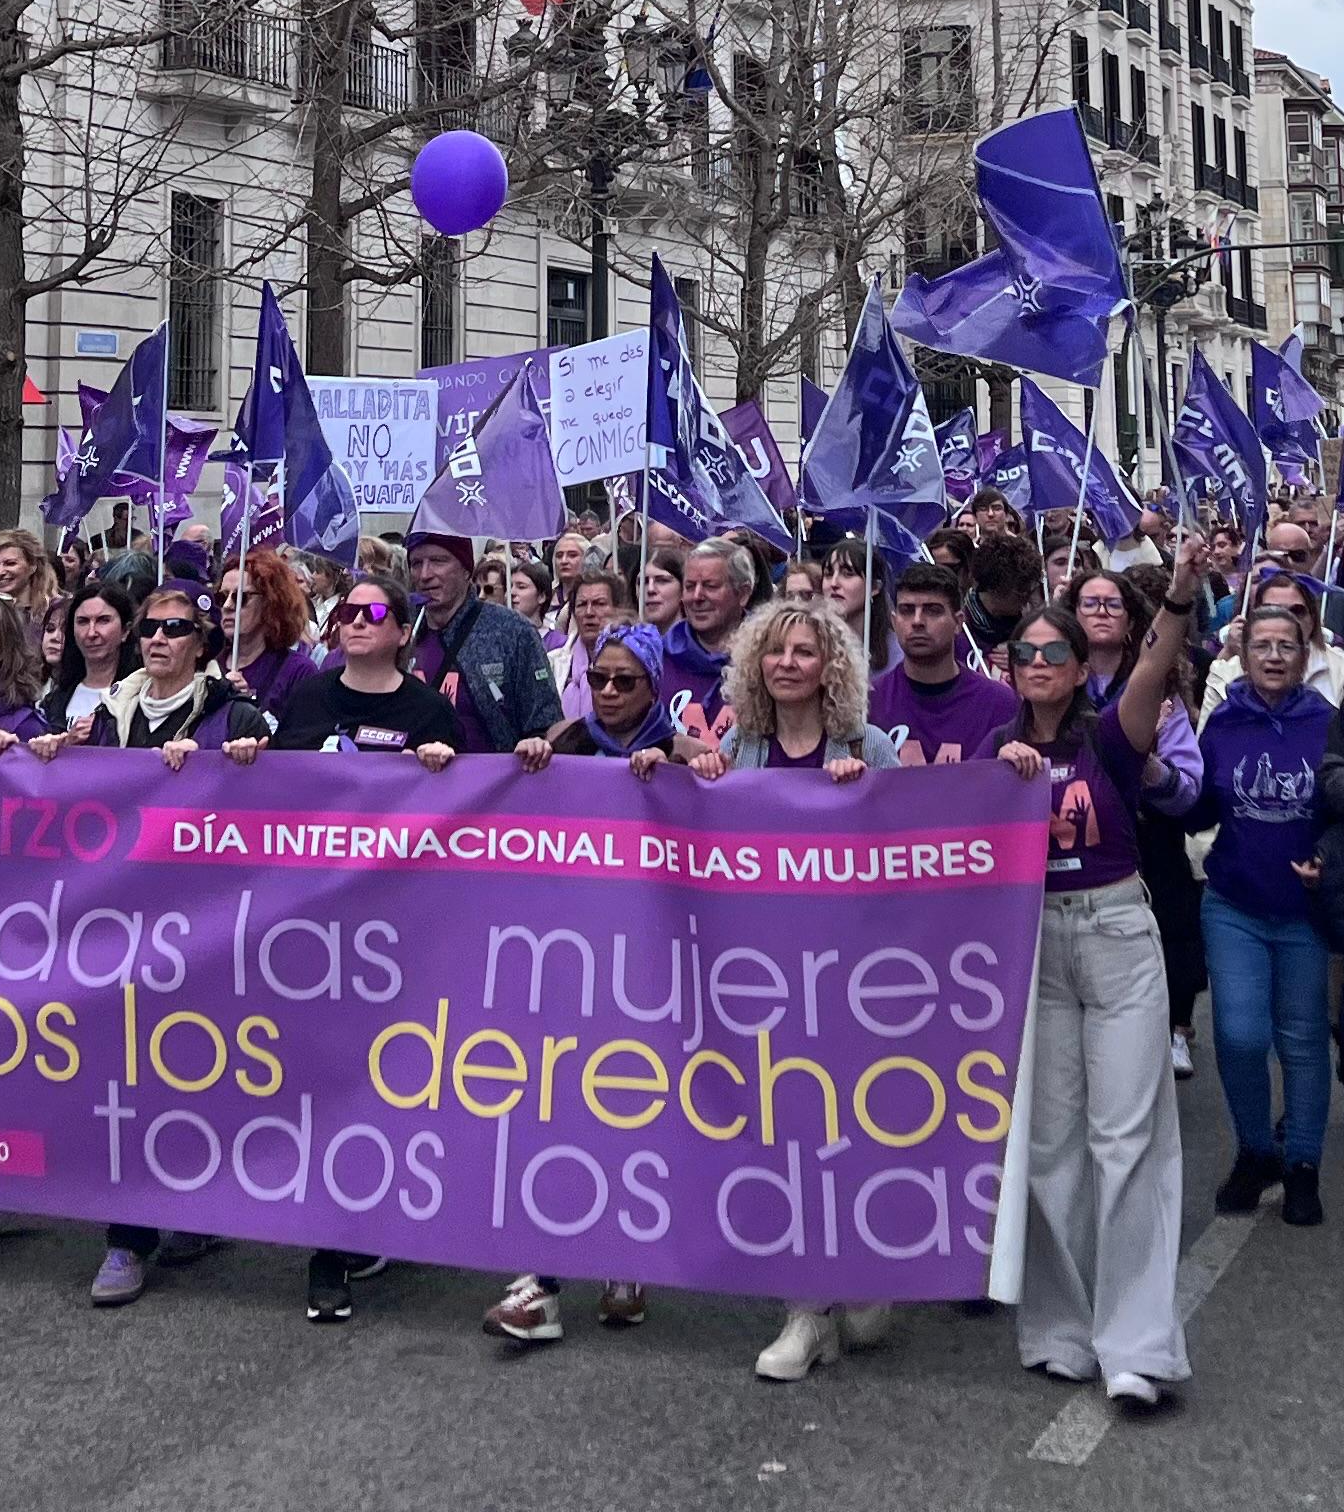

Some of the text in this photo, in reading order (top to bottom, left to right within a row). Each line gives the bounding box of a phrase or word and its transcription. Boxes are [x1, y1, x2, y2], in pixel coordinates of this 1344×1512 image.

[588, 353, 609, 371] me
[311, 384, 430, 420] ALLADITA
[583, 375, 624, 401] elegir
[347, 423, 392, 459] NO
[359, 728, 394, 742] CCOO
[172, 813, 996, 885] DÍA INTERNACIONAL DE LAS MUJERES
[234, 889, 403, 1003] las
[483, 914, 1005, 1053] mujeres
[125, 983, 285, 1098] los
[368, 998, 1013, 1148] derechos
[93, 1079, 1004, 1260] todos los días
